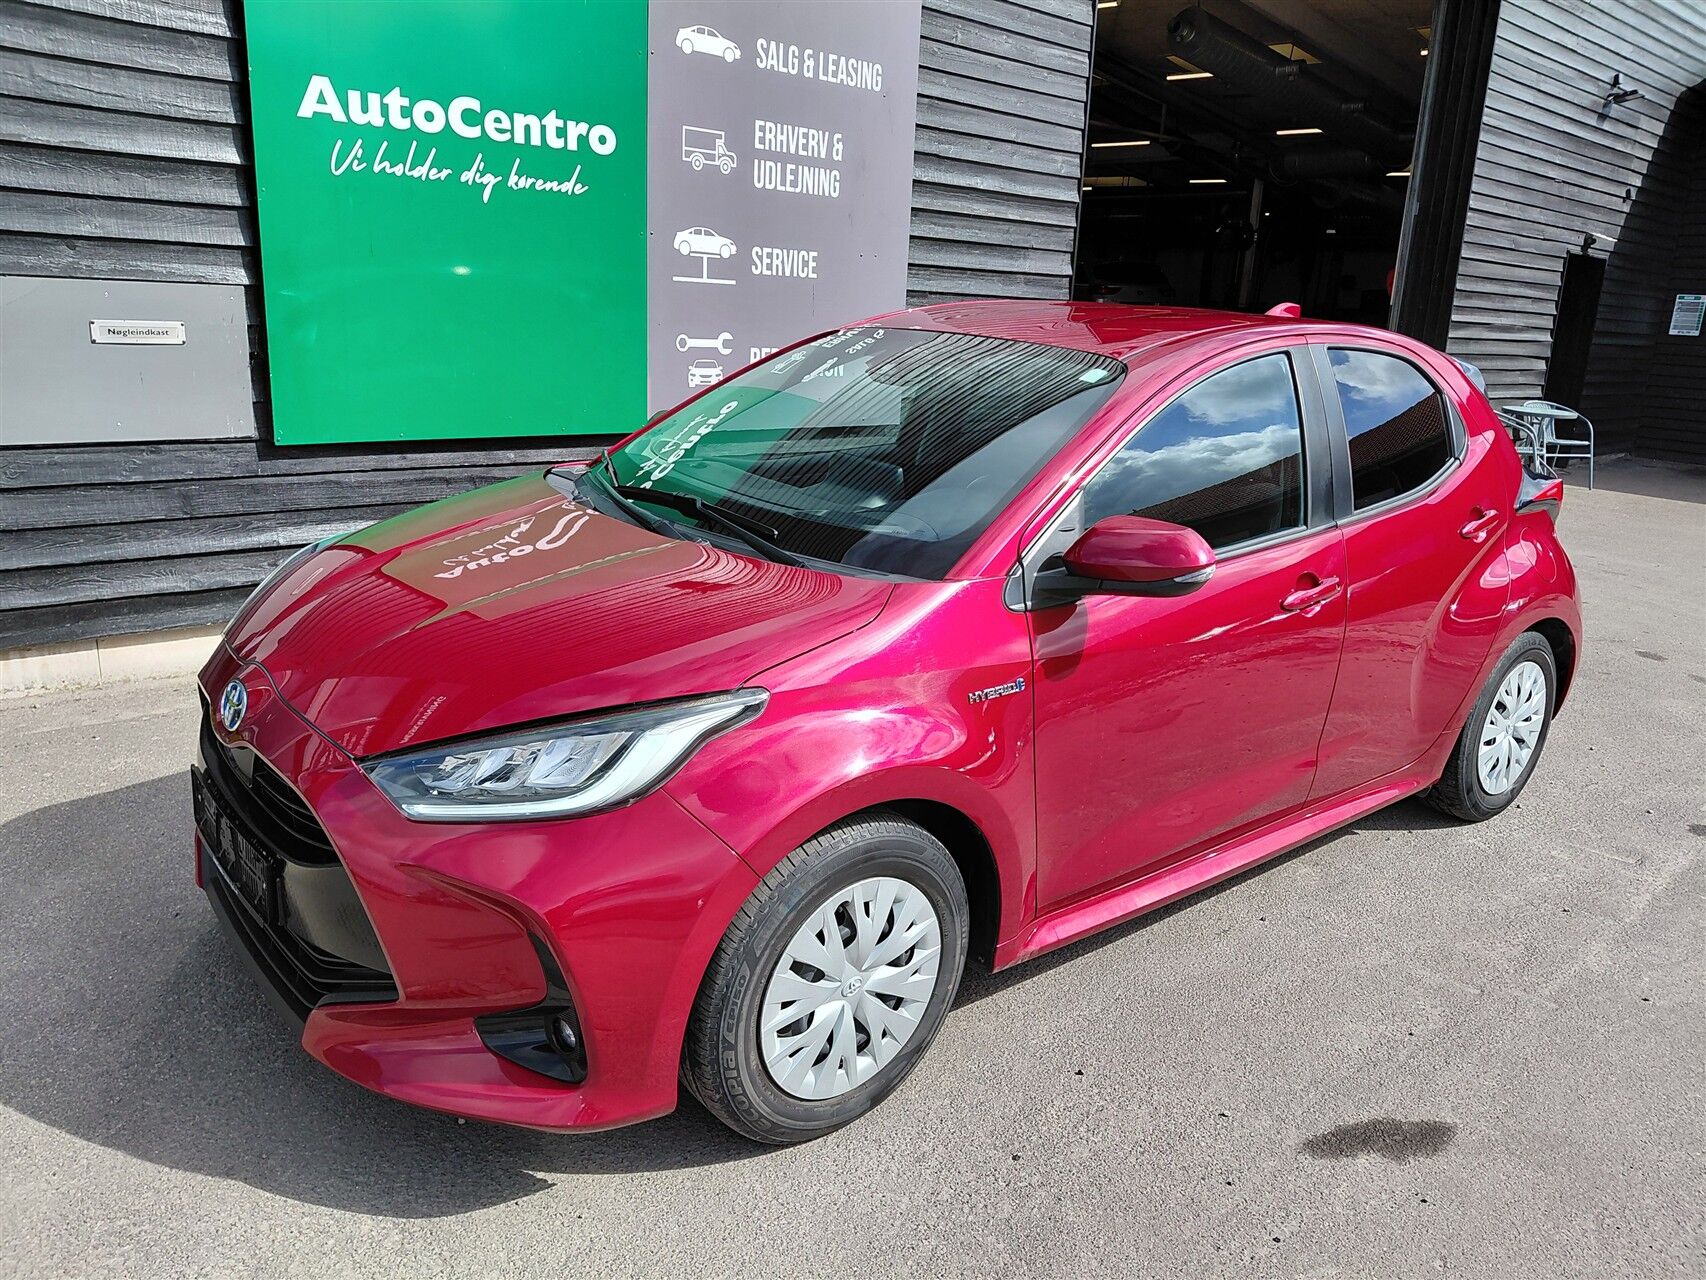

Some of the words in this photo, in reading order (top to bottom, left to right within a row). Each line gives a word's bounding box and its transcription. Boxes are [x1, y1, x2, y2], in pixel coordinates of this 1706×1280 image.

[756, 38, 799, 75] SALG
[803, 48, 815, 79] &
[818, 51, 883, 92] LEASING
[297, 74, 618, 156] AutoCentro
[754, 119, 829, 159] ERHVERV
[832, 133, 844, 162] &
[330, 138, 367, 176] Vi
[373, 139, 453, 182] holder
[460, 152, 503, 204] dig
[507, 157, 589, 196] kørende
[753, 158, 841, 198] UDLEJNING
[751, 246, 818, 279] SERVICE
[107, 328, 170, 337] Nøgleindkast
[967, 682, 1016, 705] HYBRID
